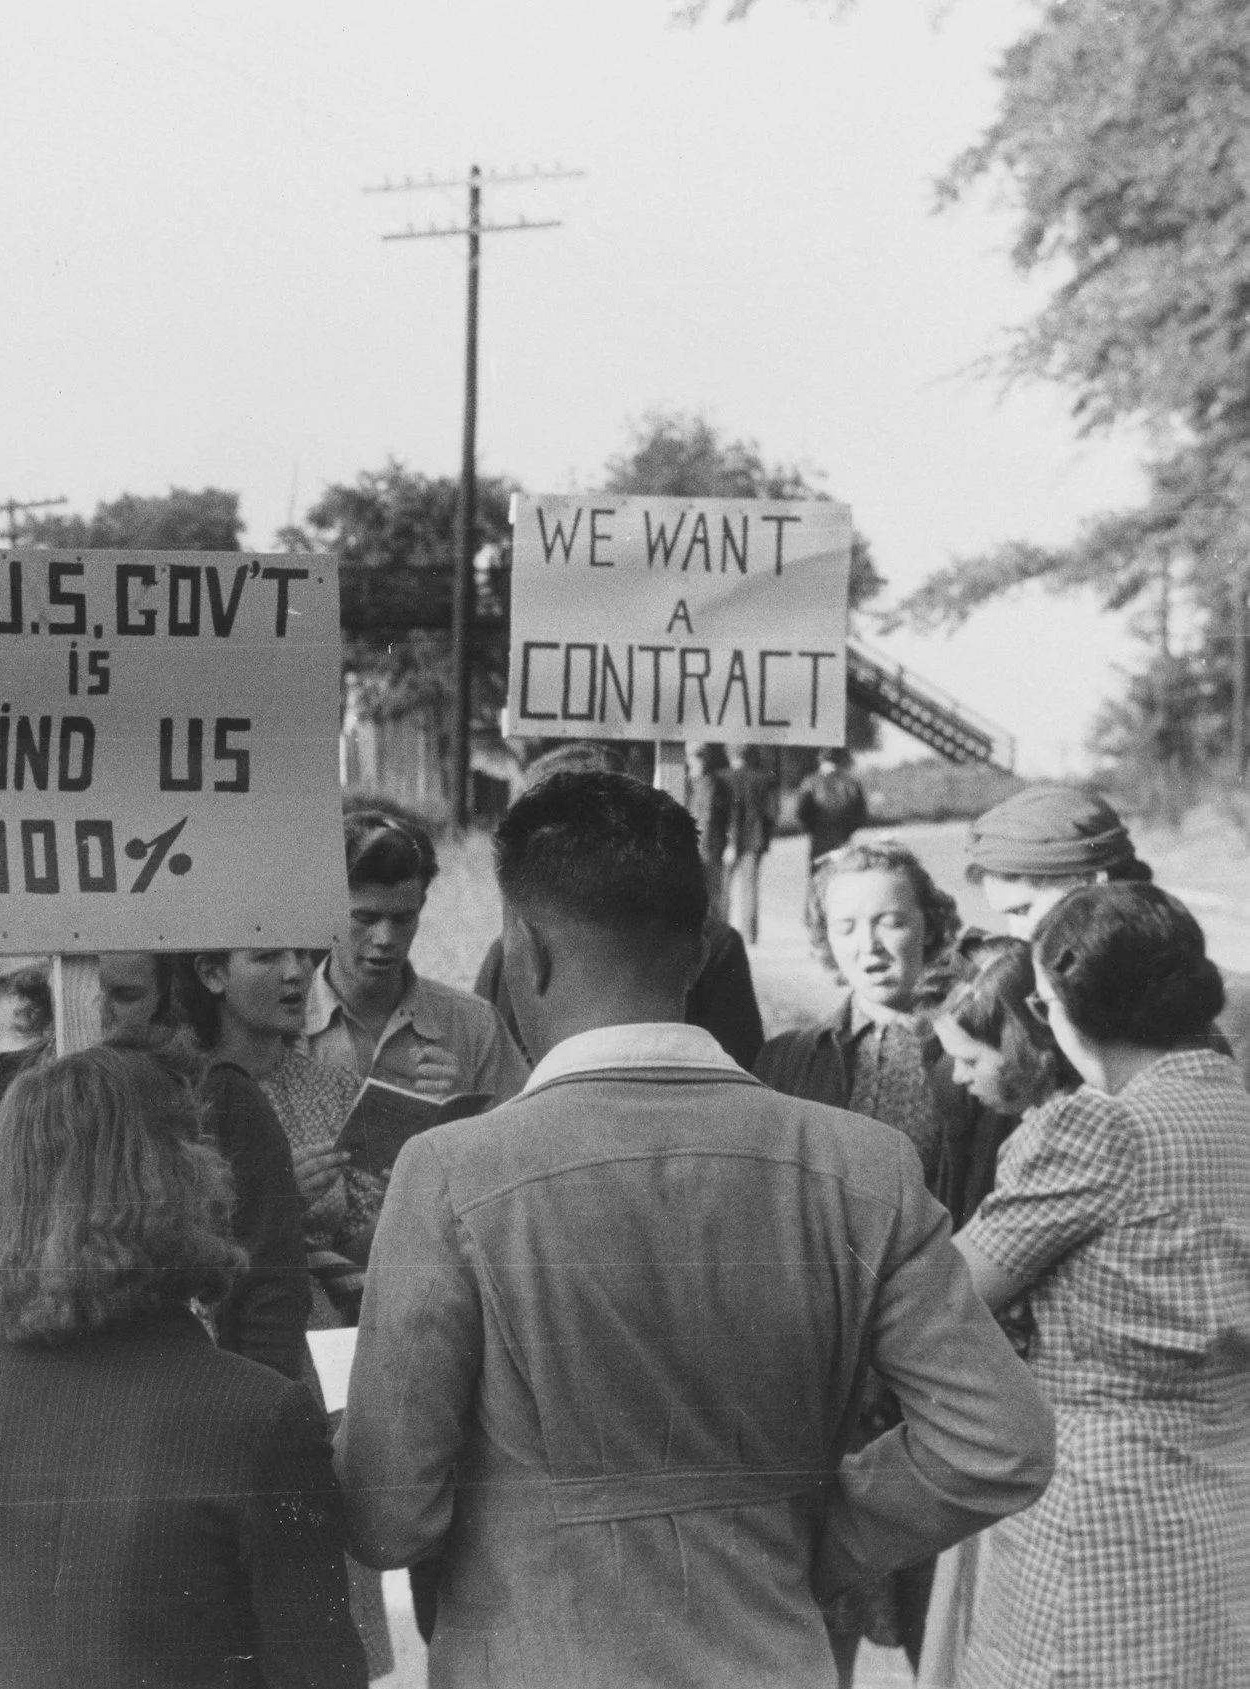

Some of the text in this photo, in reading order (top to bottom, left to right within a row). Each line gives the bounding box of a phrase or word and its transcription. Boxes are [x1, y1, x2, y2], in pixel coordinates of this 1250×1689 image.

[536, 507, 803, 576] WE WANT
[666, 599, 694, 635] A
[519, 640, 837, 729] CONTRACT
[158, 716, 252, 794] US
